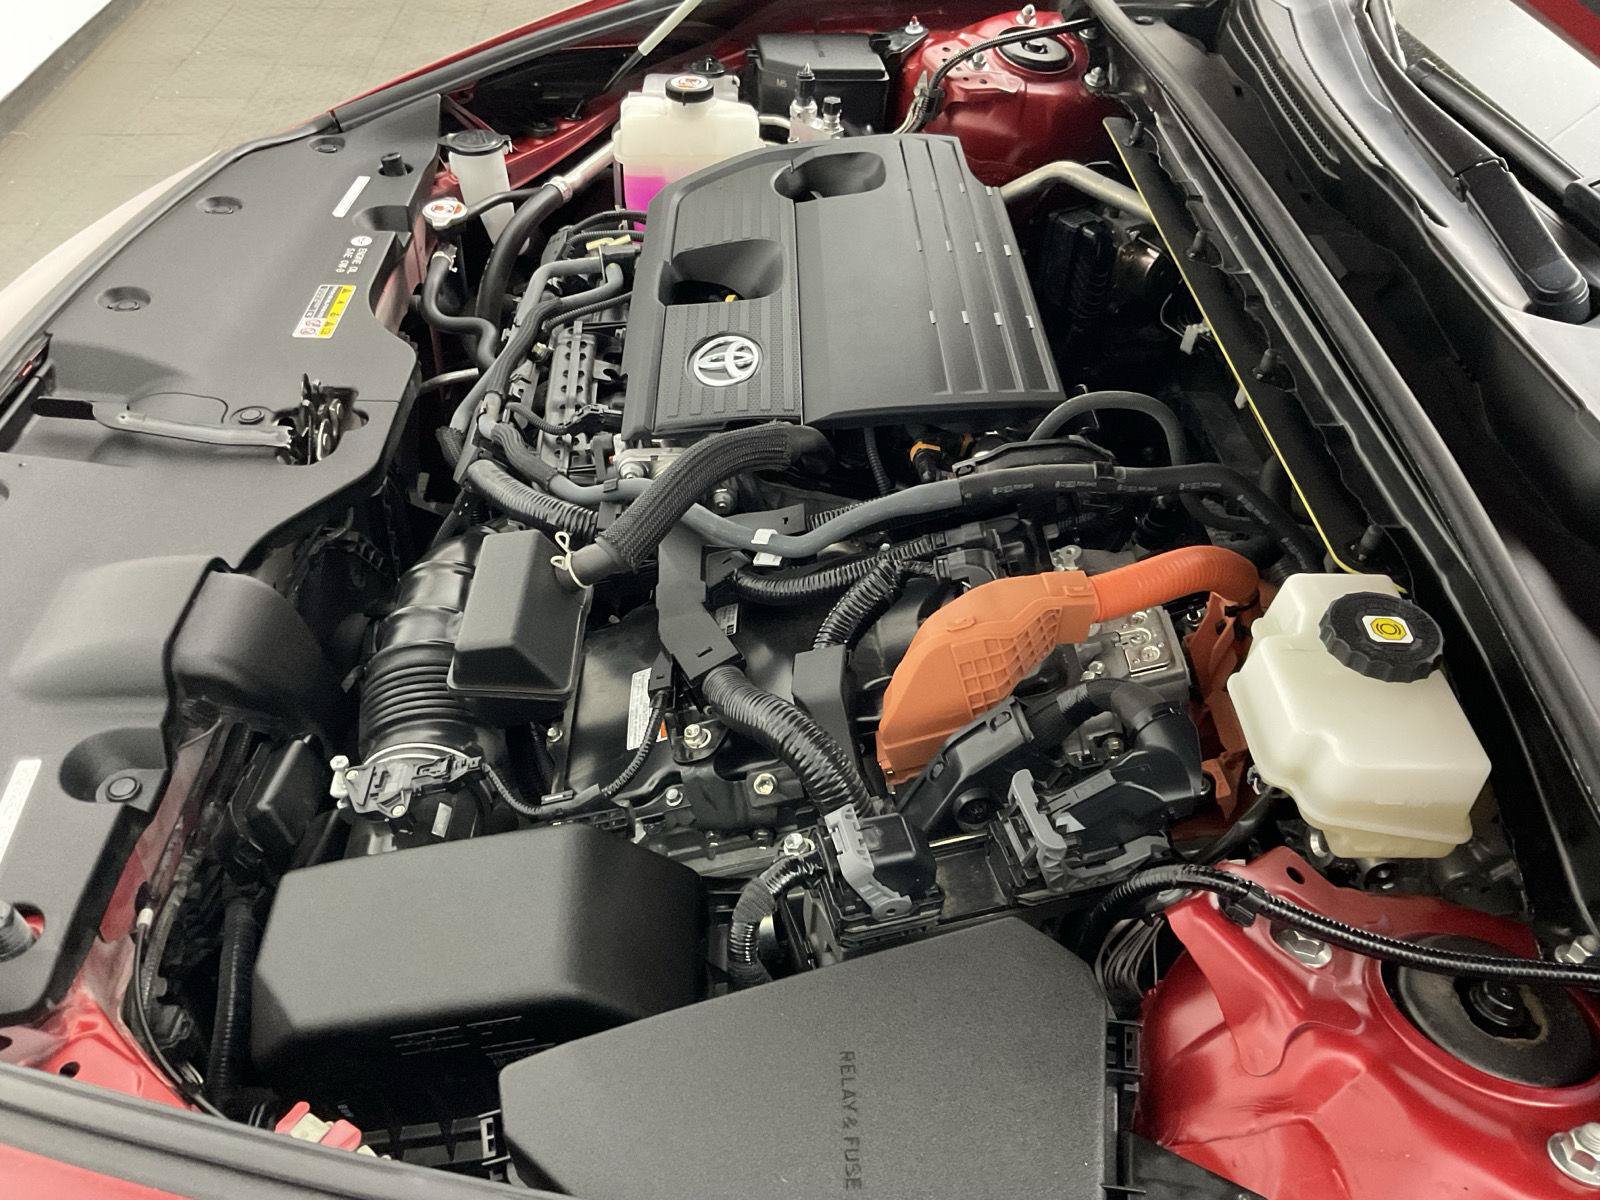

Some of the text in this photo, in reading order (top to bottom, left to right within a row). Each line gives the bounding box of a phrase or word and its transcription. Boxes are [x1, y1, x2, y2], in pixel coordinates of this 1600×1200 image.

[840, 1051, 862, 1191] RELAY & FUSE
